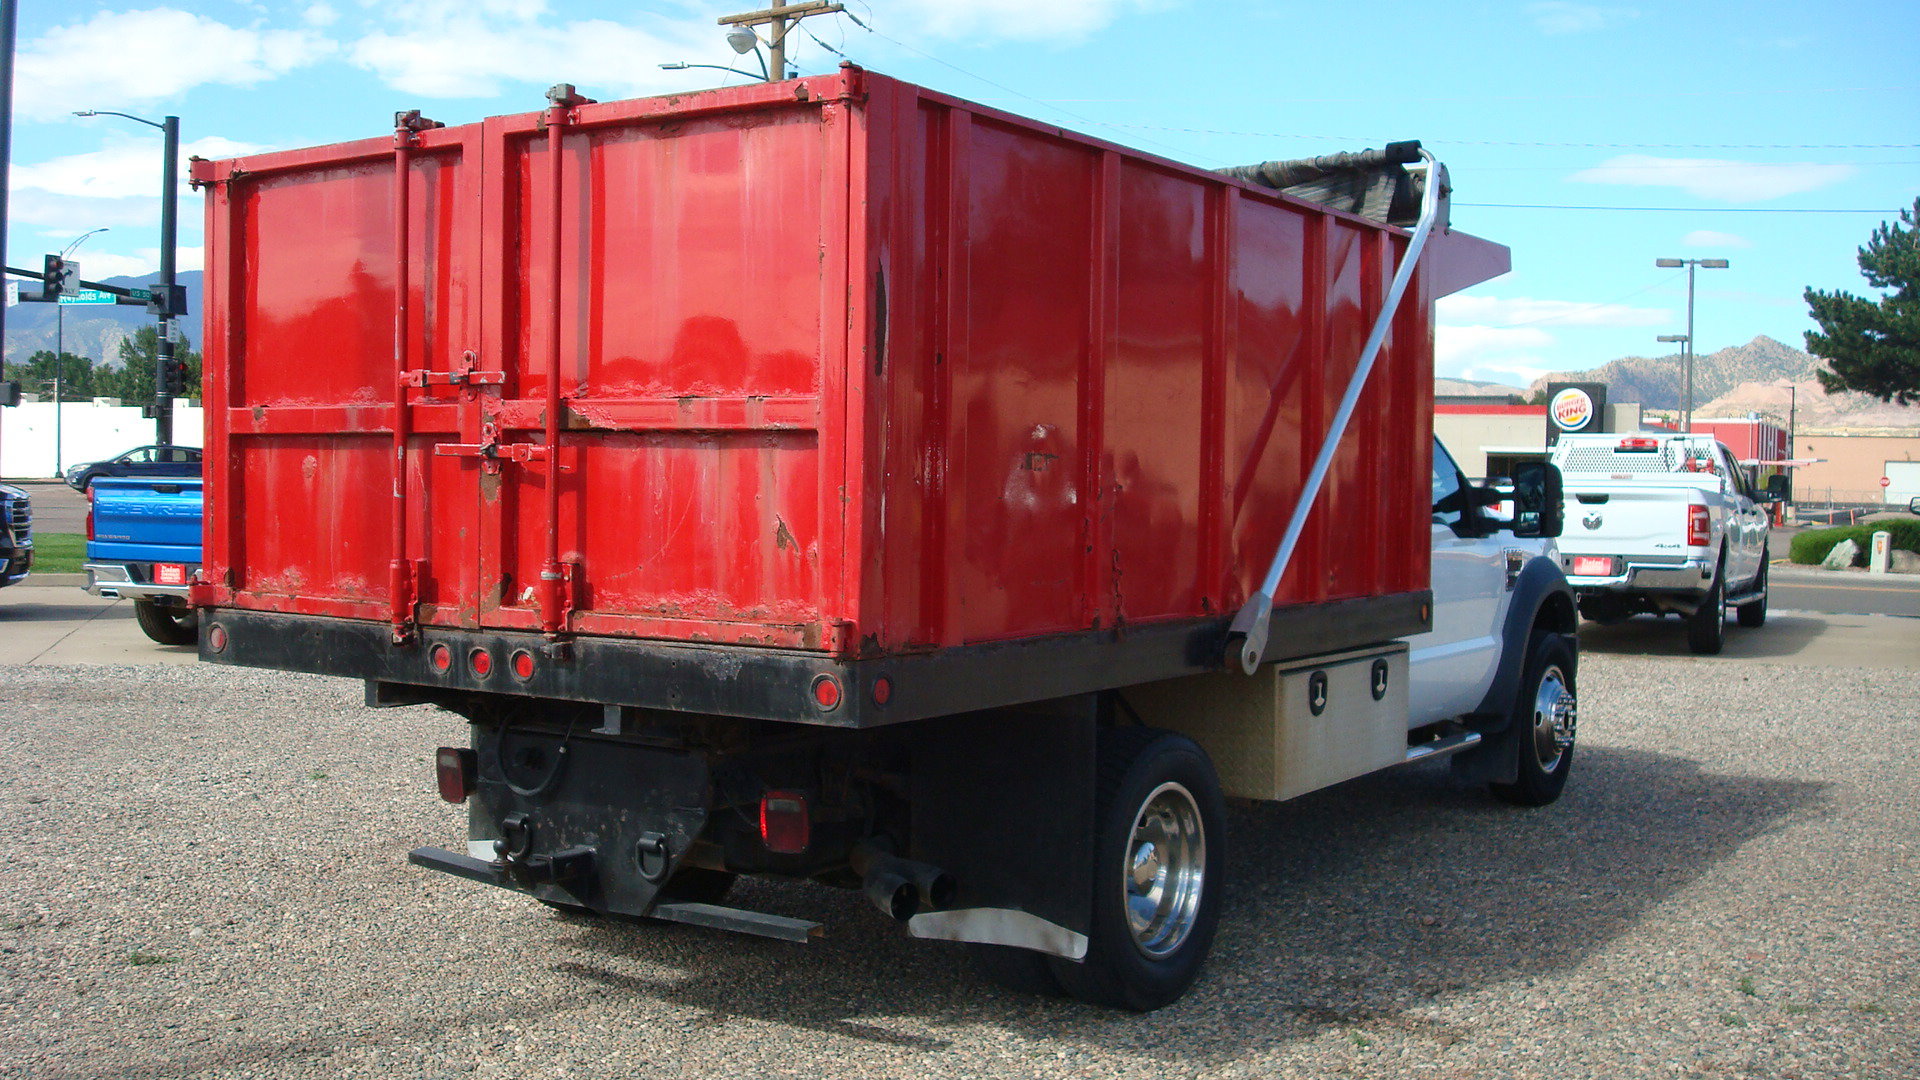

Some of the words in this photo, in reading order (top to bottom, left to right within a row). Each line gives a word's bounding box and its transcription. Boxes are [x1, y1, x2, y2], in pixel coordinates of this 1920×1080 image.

[1557, 397, 1585, 410] BURGER
[1558, 404, 1586, 419] KING
[100, 503, 203, 516] CHEVROL
